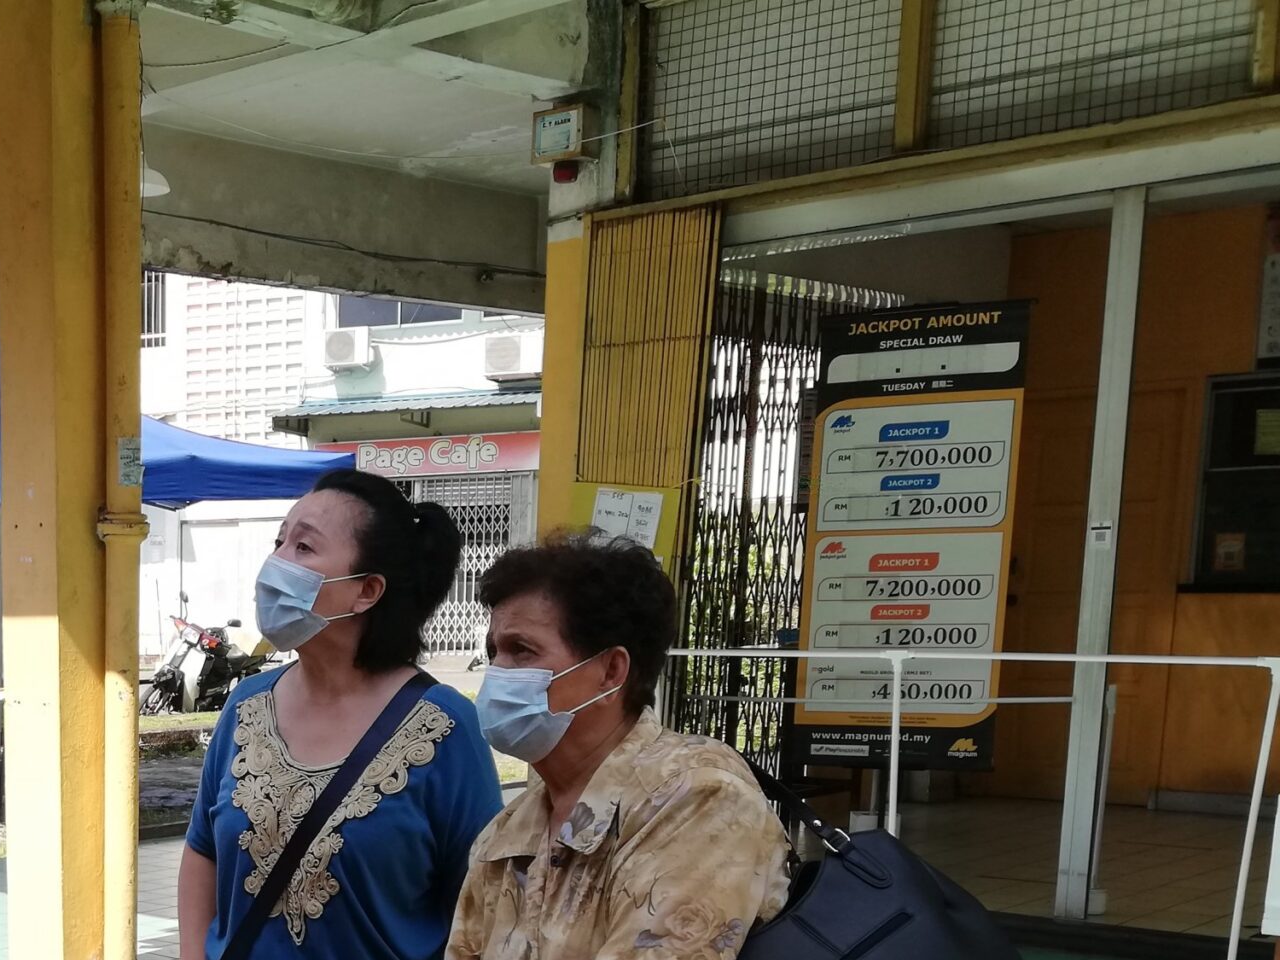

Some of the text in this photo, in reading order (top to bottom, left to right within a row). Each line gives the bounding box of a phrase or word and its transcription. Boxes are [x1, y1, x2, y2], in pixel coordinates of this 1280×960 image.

[848, 311, 1002, 336] JACKPOT AMOUNT
[879, 334, 963, 349] SPECIAL DRAW
[882, 381, 926, 392] TUESDAY
[887, 428, 931, 437] JACKPOT
[358, 435, 499, 474] Page Cafe
[838, 446, 992, 468] RM 7,700,000
[887, 479, 924, 487] JACKPOT
[877, 559, 920, 567] JACKPOT
[866, 578, 981, 598] 7,200,000
[812, 732, 931, 743] www.magnumd.my
[947, 751, 978, 759] magnum
